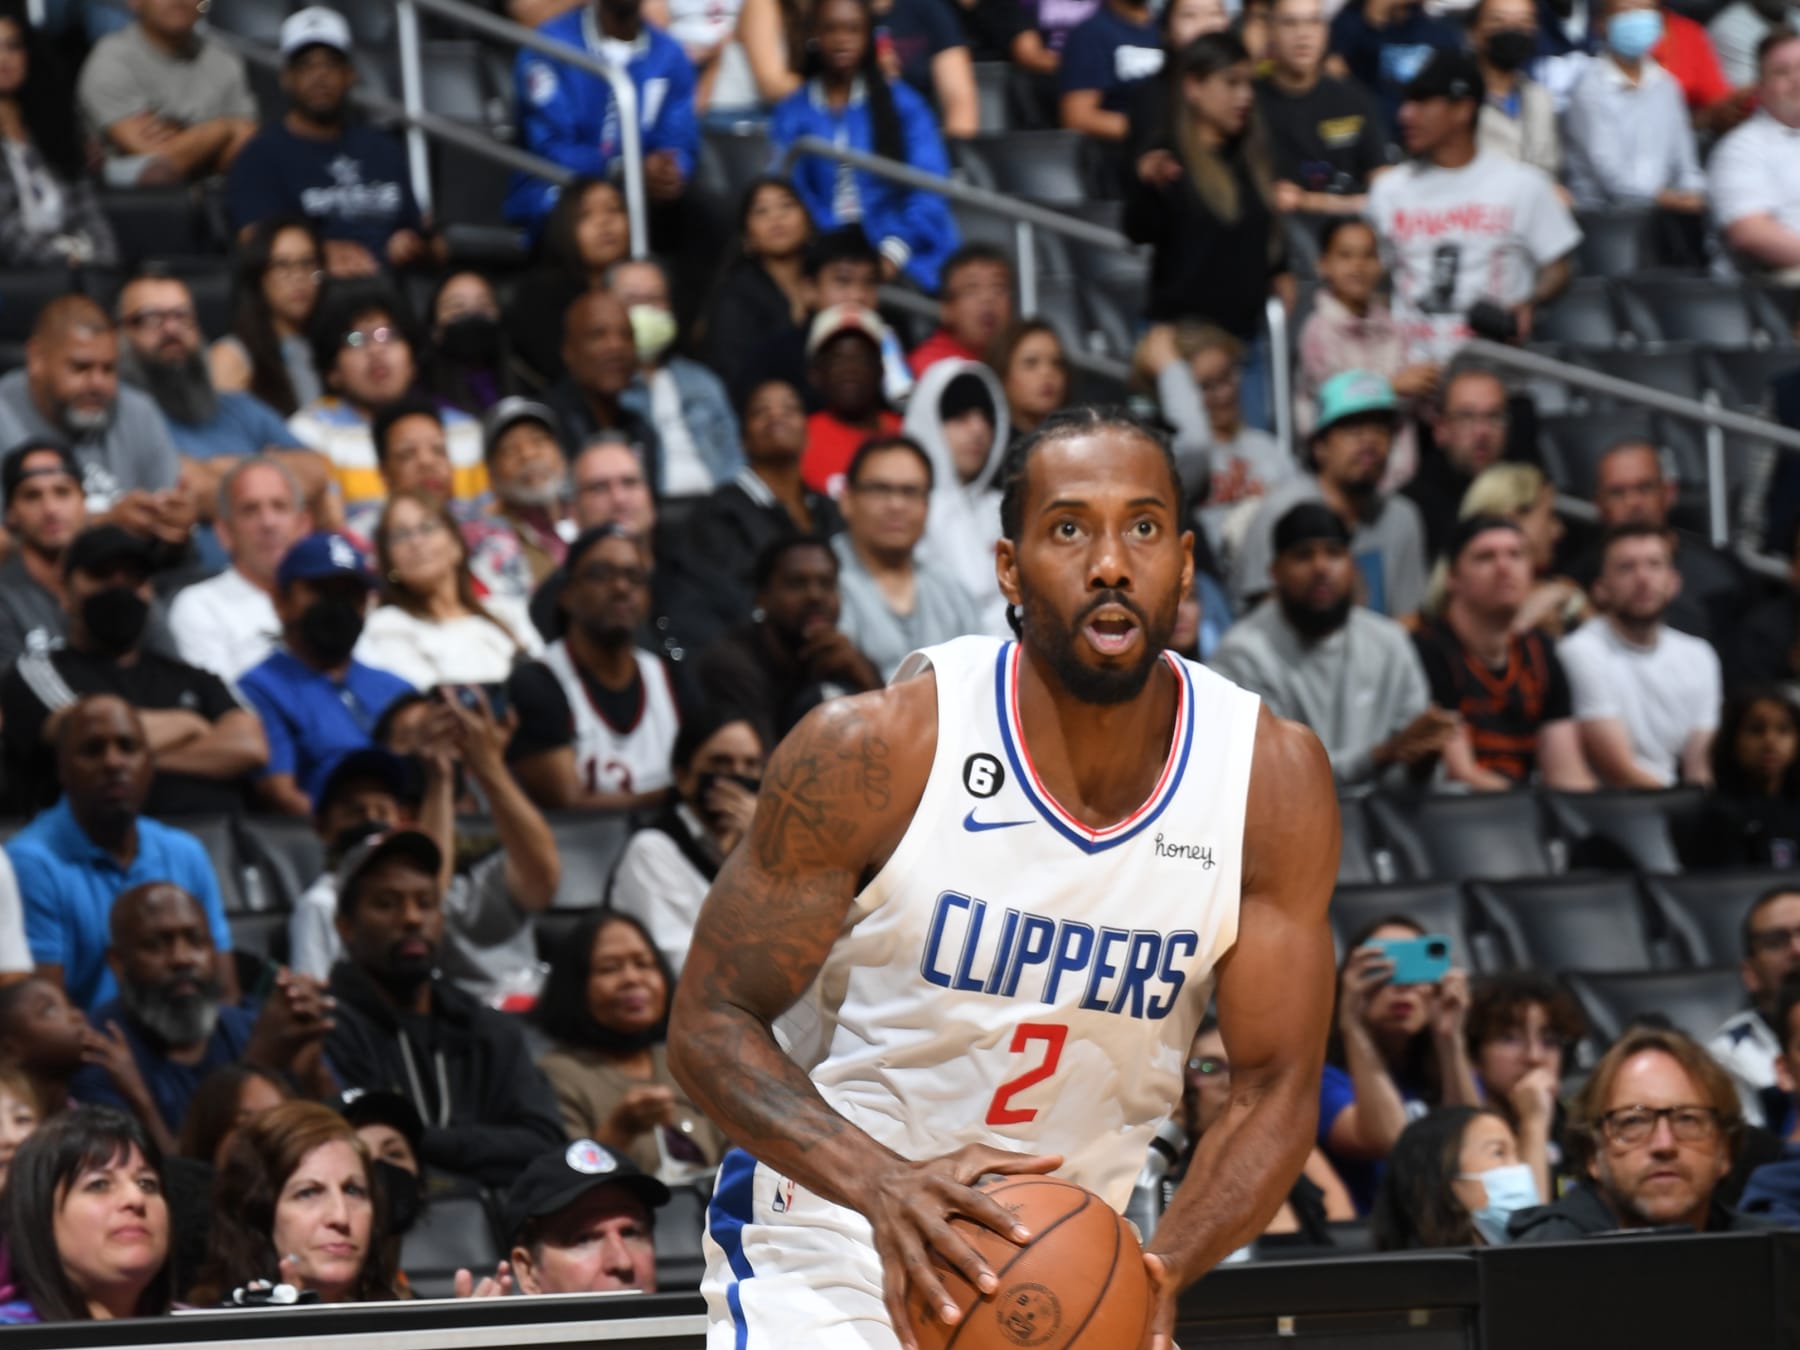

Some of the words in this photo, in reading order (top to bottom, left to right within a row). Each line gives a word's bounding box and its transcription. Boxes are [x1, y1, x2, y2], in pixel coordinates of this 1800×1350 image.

[968, 757, 998, 798] 6
[1154, 833, 1216, 870] honey
[920, 889, 1199, 1021] CLIPPERS
[985, 1022, 1069, 1126] 2
